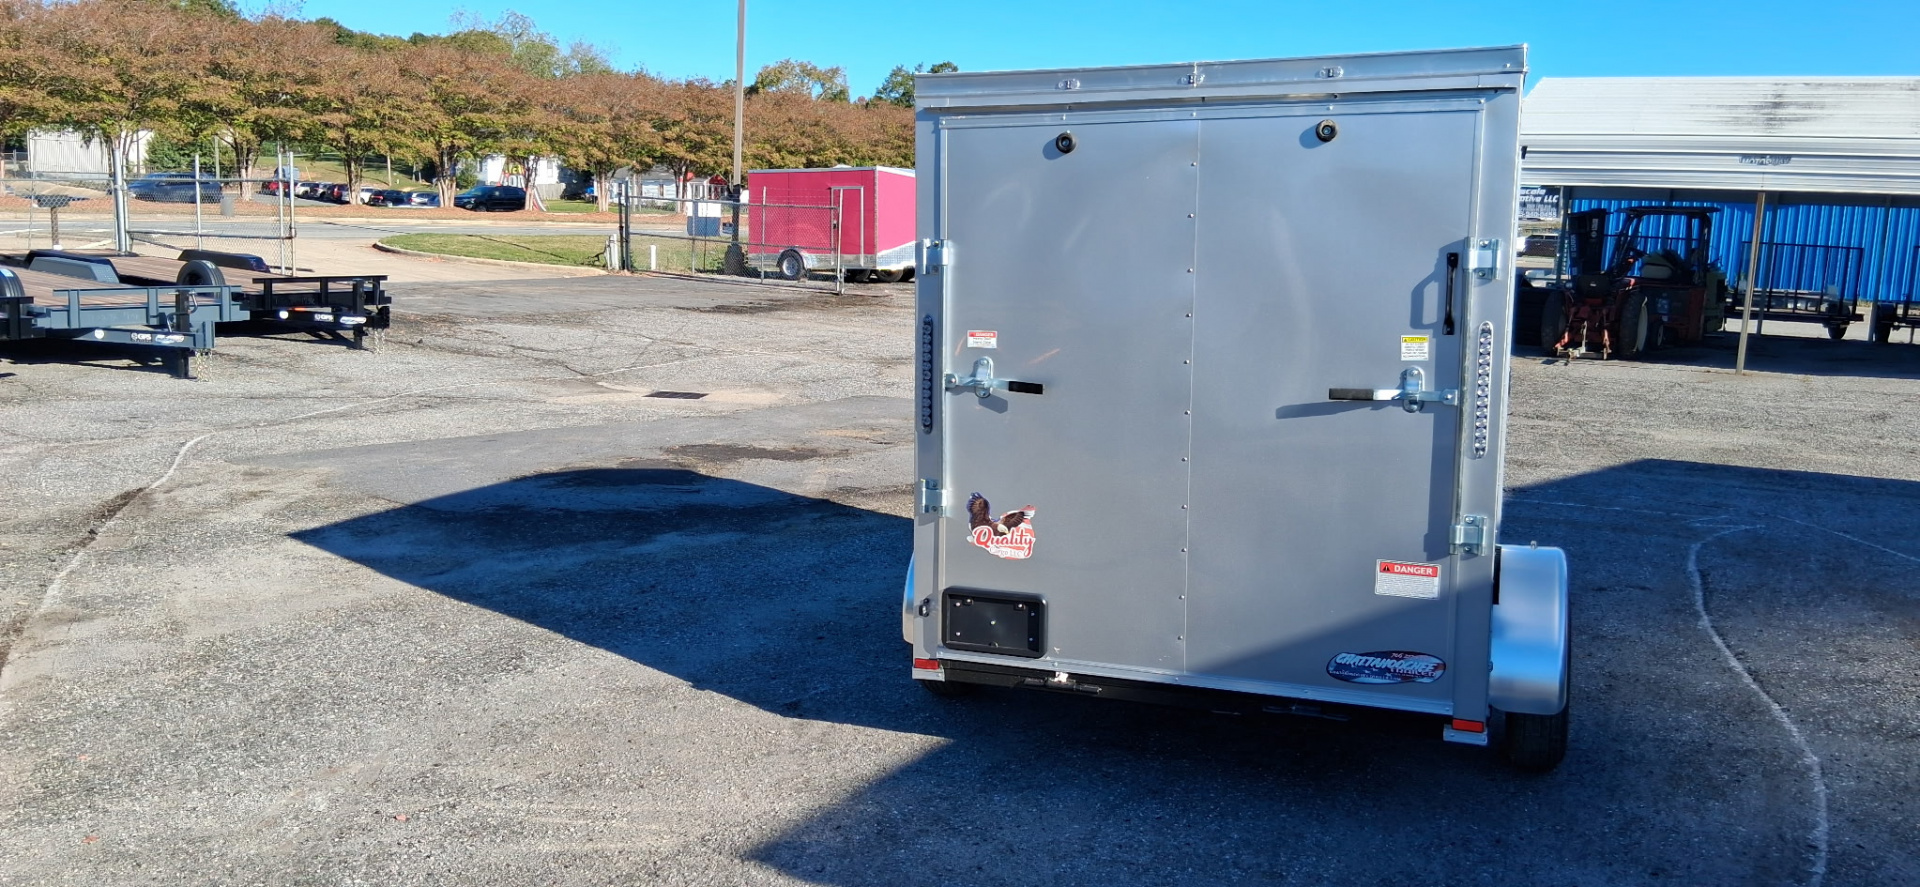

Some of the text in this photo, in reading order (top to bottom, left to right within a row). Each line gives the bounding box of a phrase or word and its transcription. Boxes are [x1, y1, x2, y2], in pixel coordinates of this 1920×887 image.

[1544, 195, 1559, 203] LLC
[973, 526, 1033, 557] Quality
[1394, 565, 1433, 575] DANGER
[1336, 652, 1438, 673] CHATTAHOOCHEE
